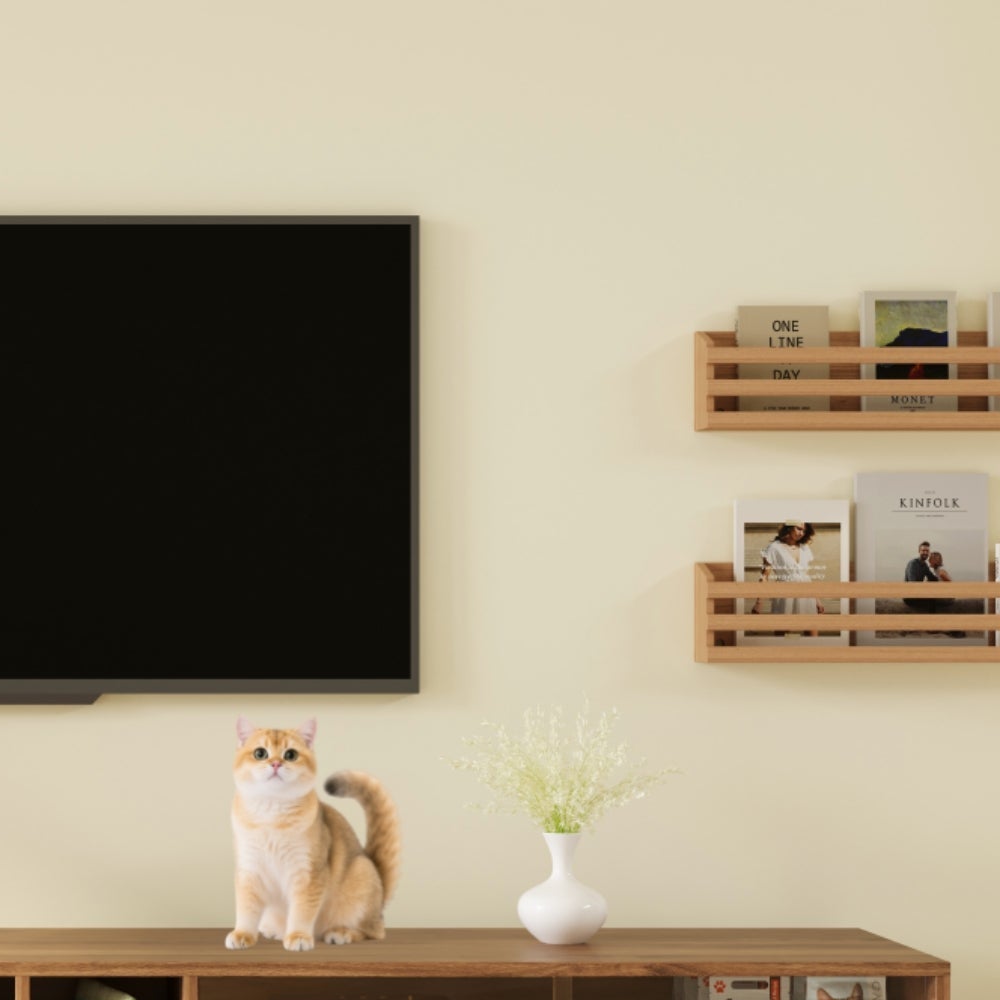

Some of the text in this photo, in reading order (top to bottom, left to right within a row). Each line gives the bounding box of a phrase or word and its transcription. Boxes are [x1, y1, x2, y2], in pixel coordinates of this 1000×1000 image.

[772, 319, 799, 332] ONE
[769, 336, 804, 348] LINE
[773, 369, 801, 380] DAY
[890, 395, 935, 404] MONET
[900, 498, 960, 508] KINFOLK
